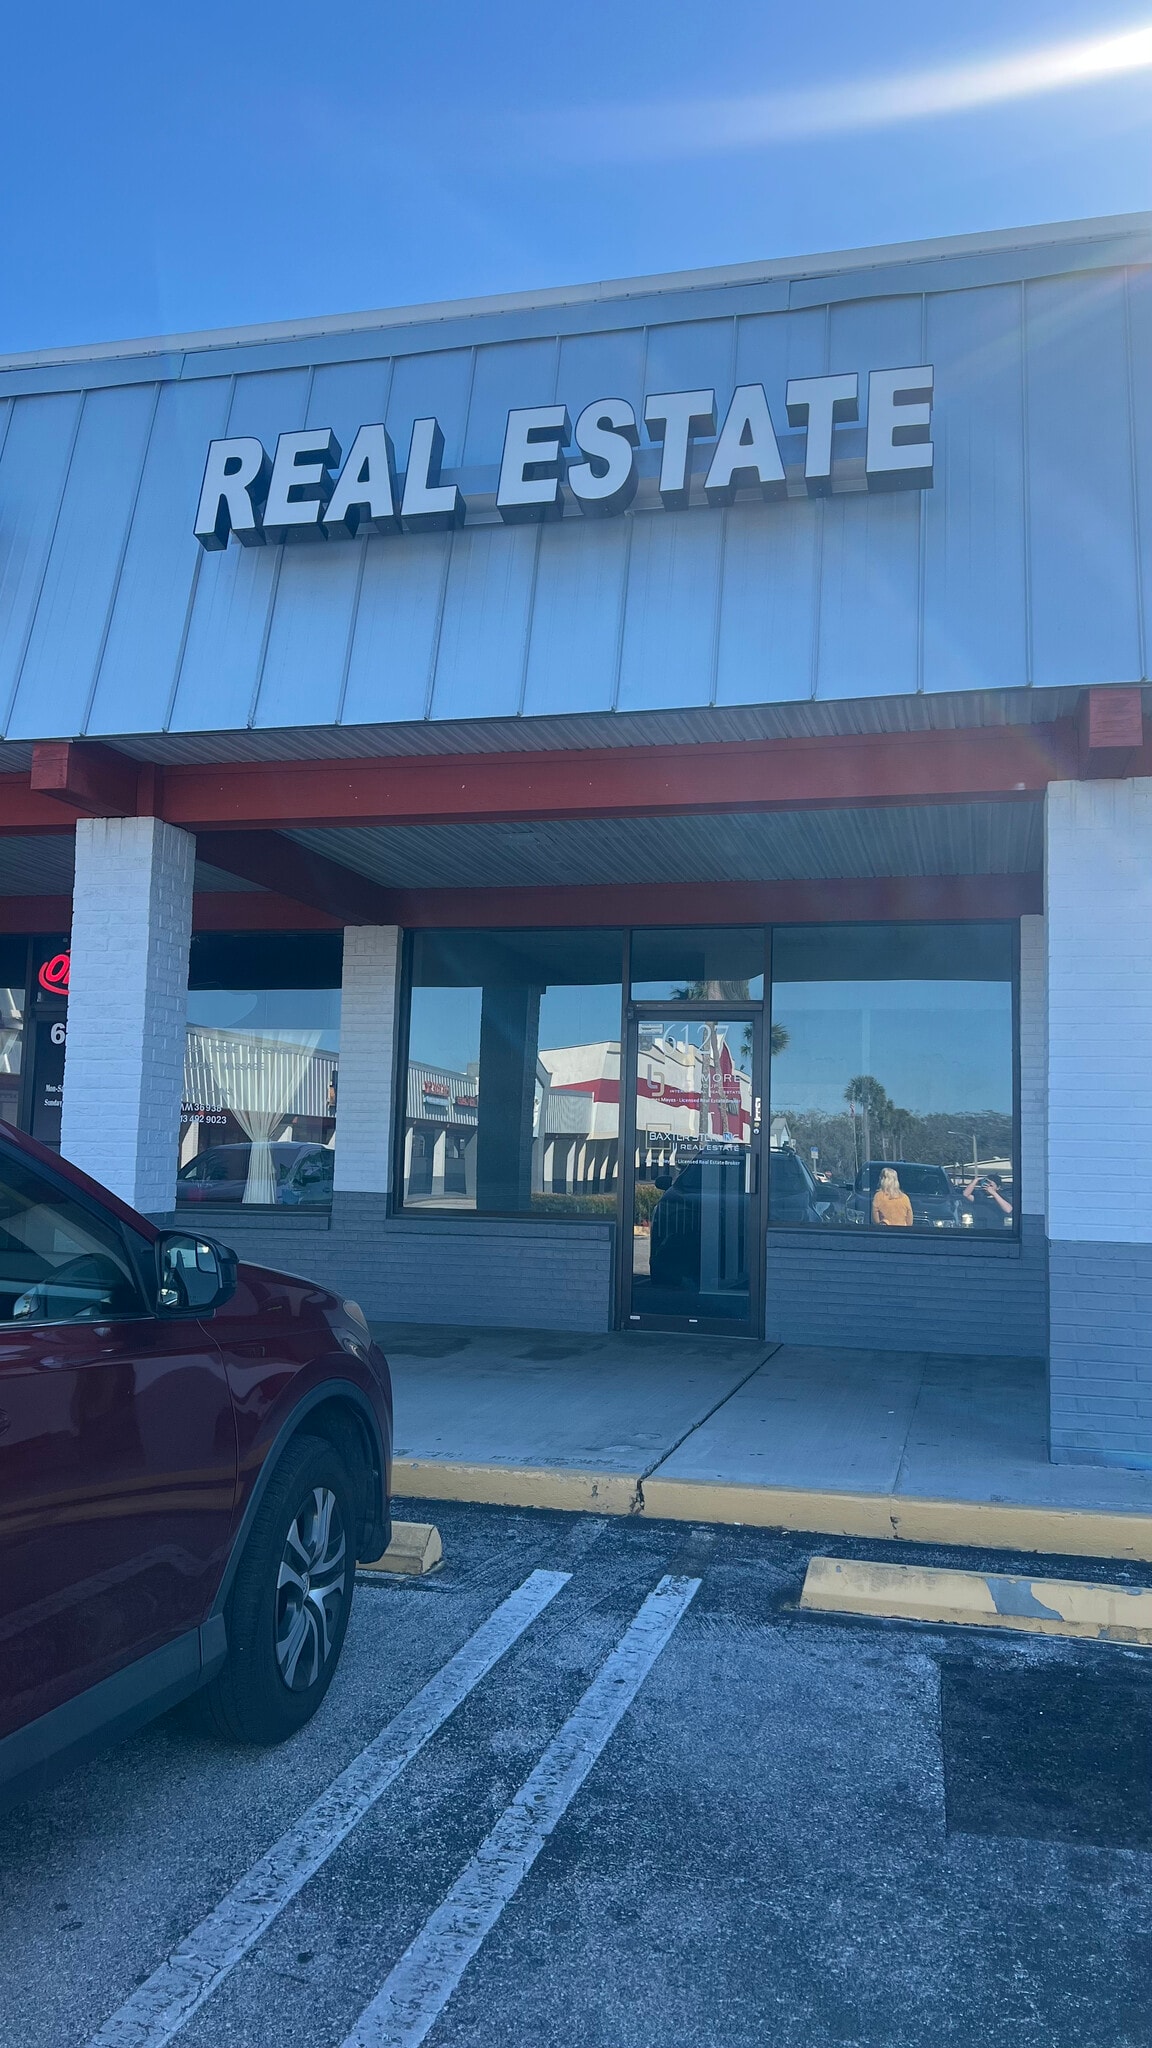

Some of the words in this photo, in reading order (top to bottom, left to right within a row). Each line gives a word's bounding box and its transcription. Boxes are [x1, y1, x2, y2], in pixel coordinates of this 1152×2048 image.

[194, 416, 464, 546] REAL
[496, 364, 934, 516] ESTATE
[662, 1023, 730, 1055] 6127
[205, 1115, 227, 1125] 9023
[680, 1143, 705, 1152] REAL
[706, 1144, 740, 1153] ESTATE
